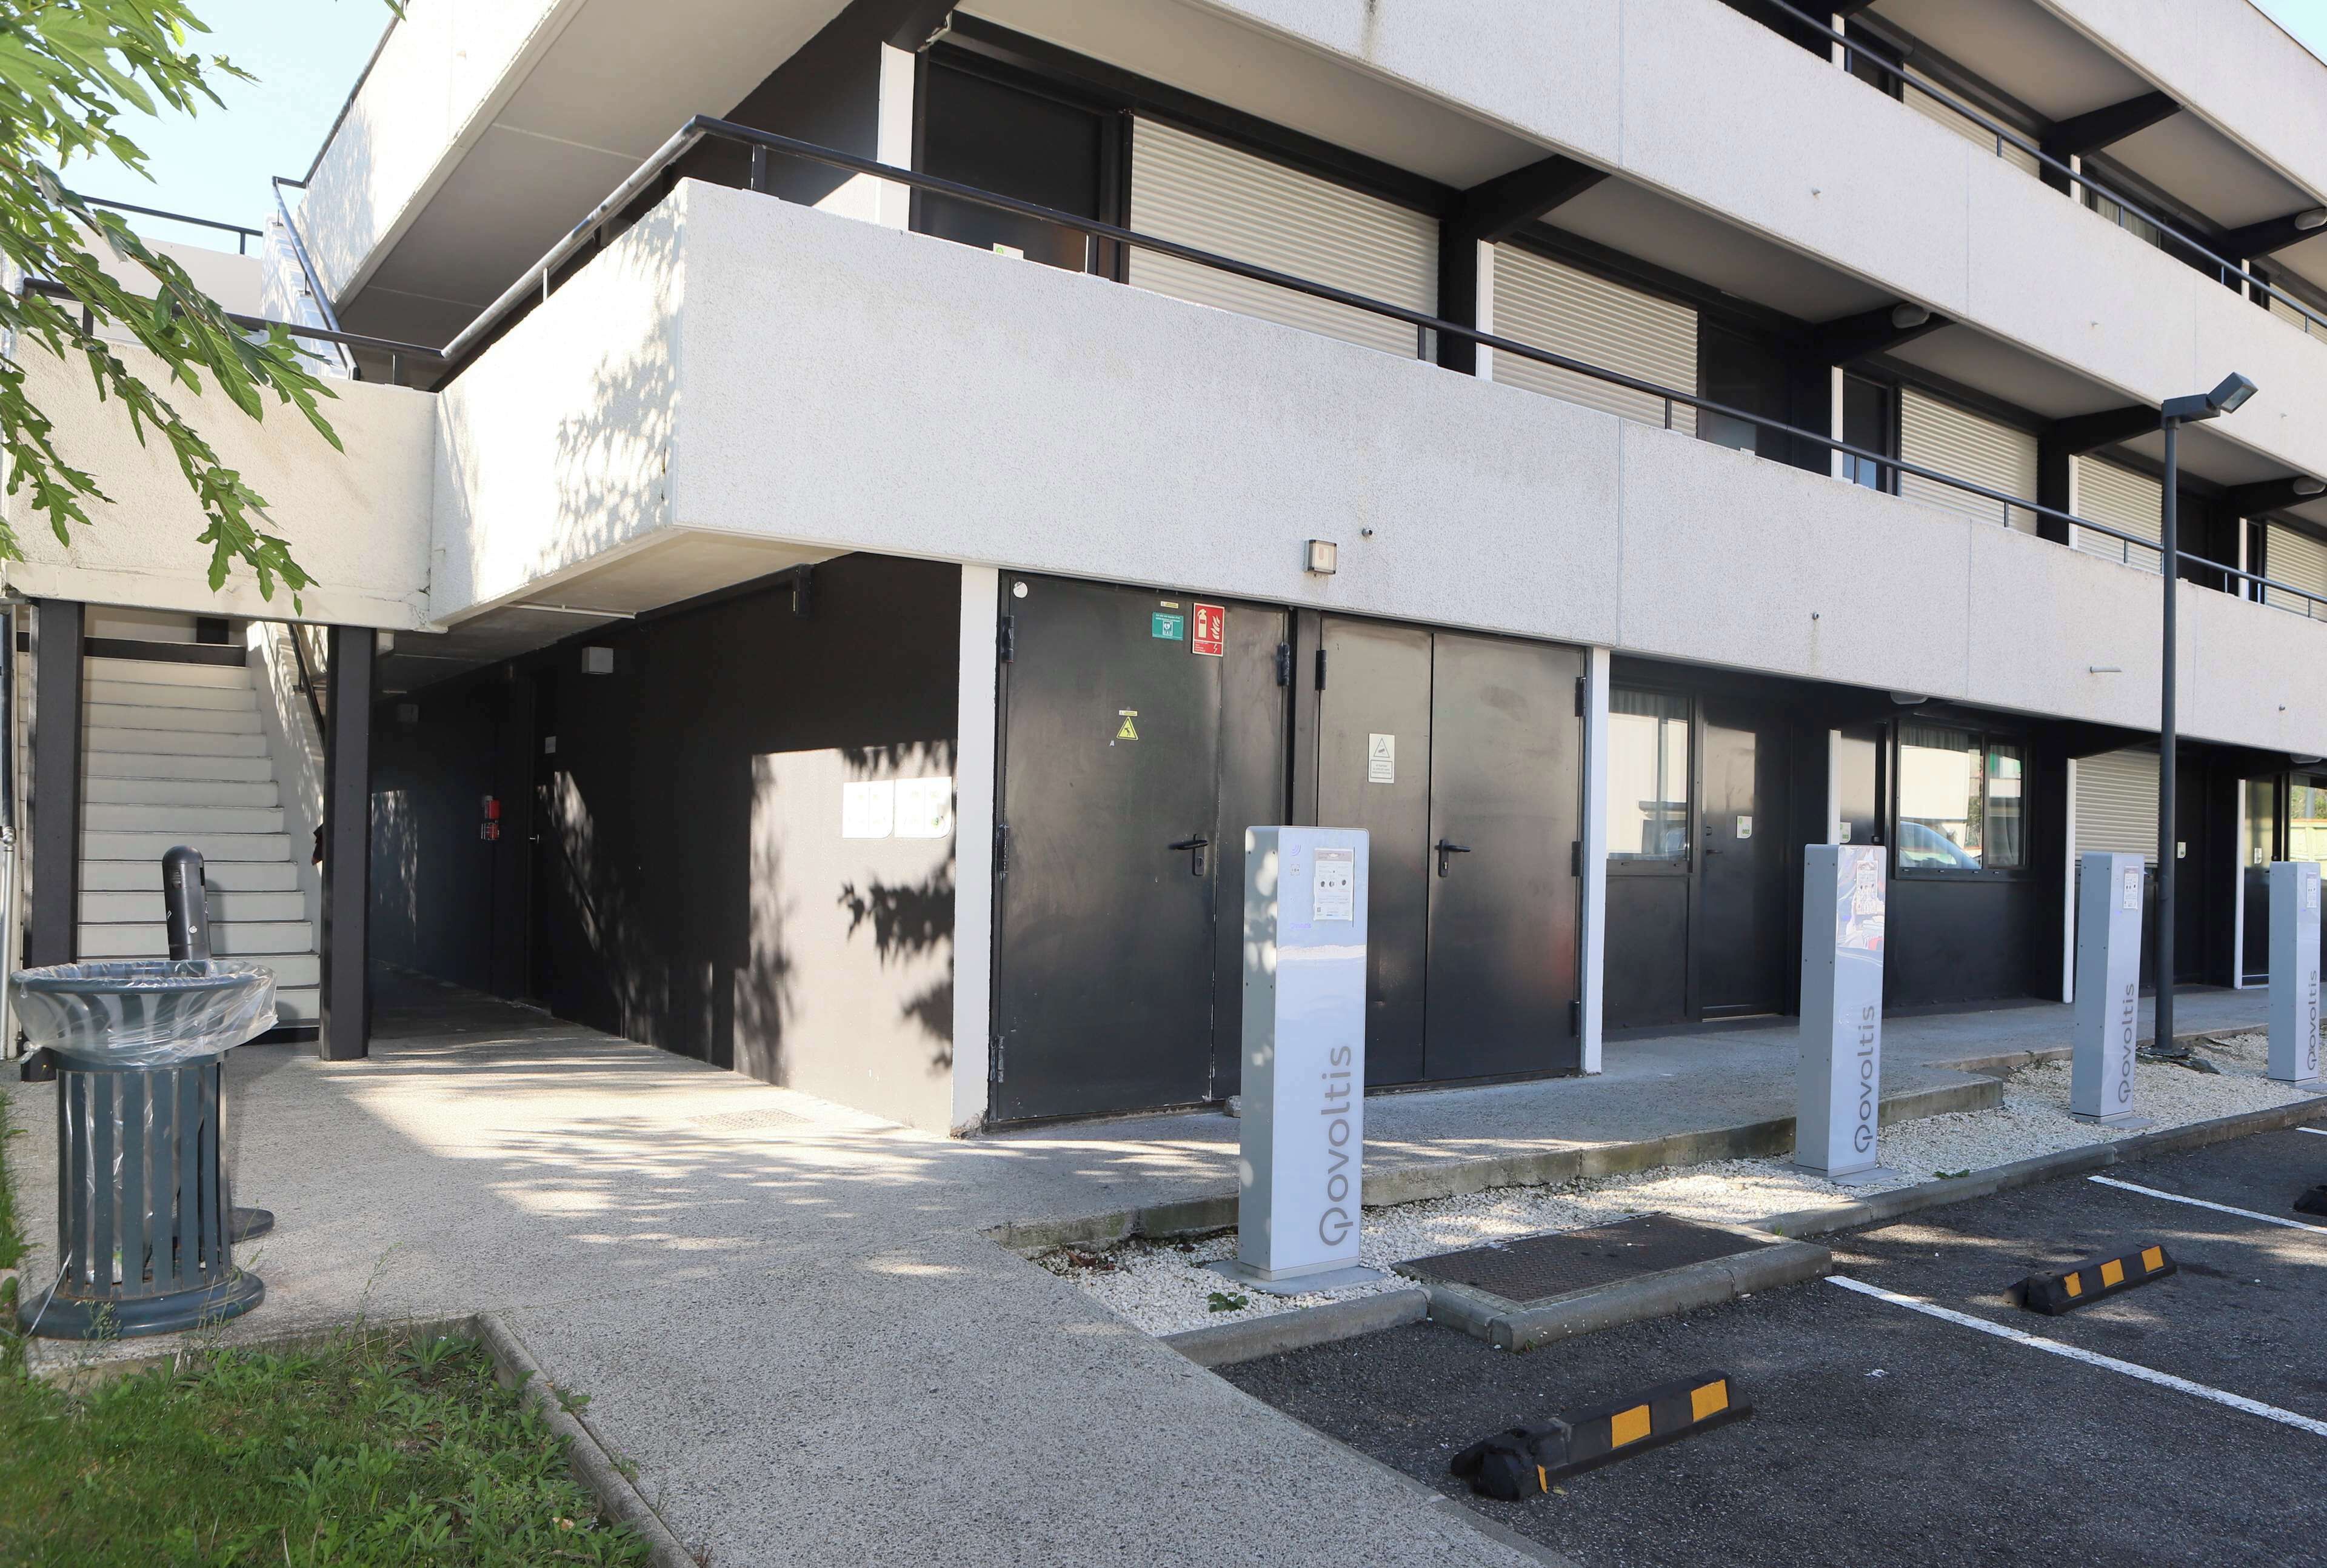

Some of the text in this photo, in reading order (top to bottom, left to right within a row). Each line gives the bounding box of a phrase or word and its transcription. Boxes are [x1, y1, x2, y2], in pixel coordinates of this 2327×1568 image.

[1855, 1005, 1875, 1153] Qovoltis
[2118, 983, 2134, 1104] Qovoltis
[2308, 970, 2317, 1071] Qovoltis
[1319, 1046, 1354, 1247] Qovoltis
